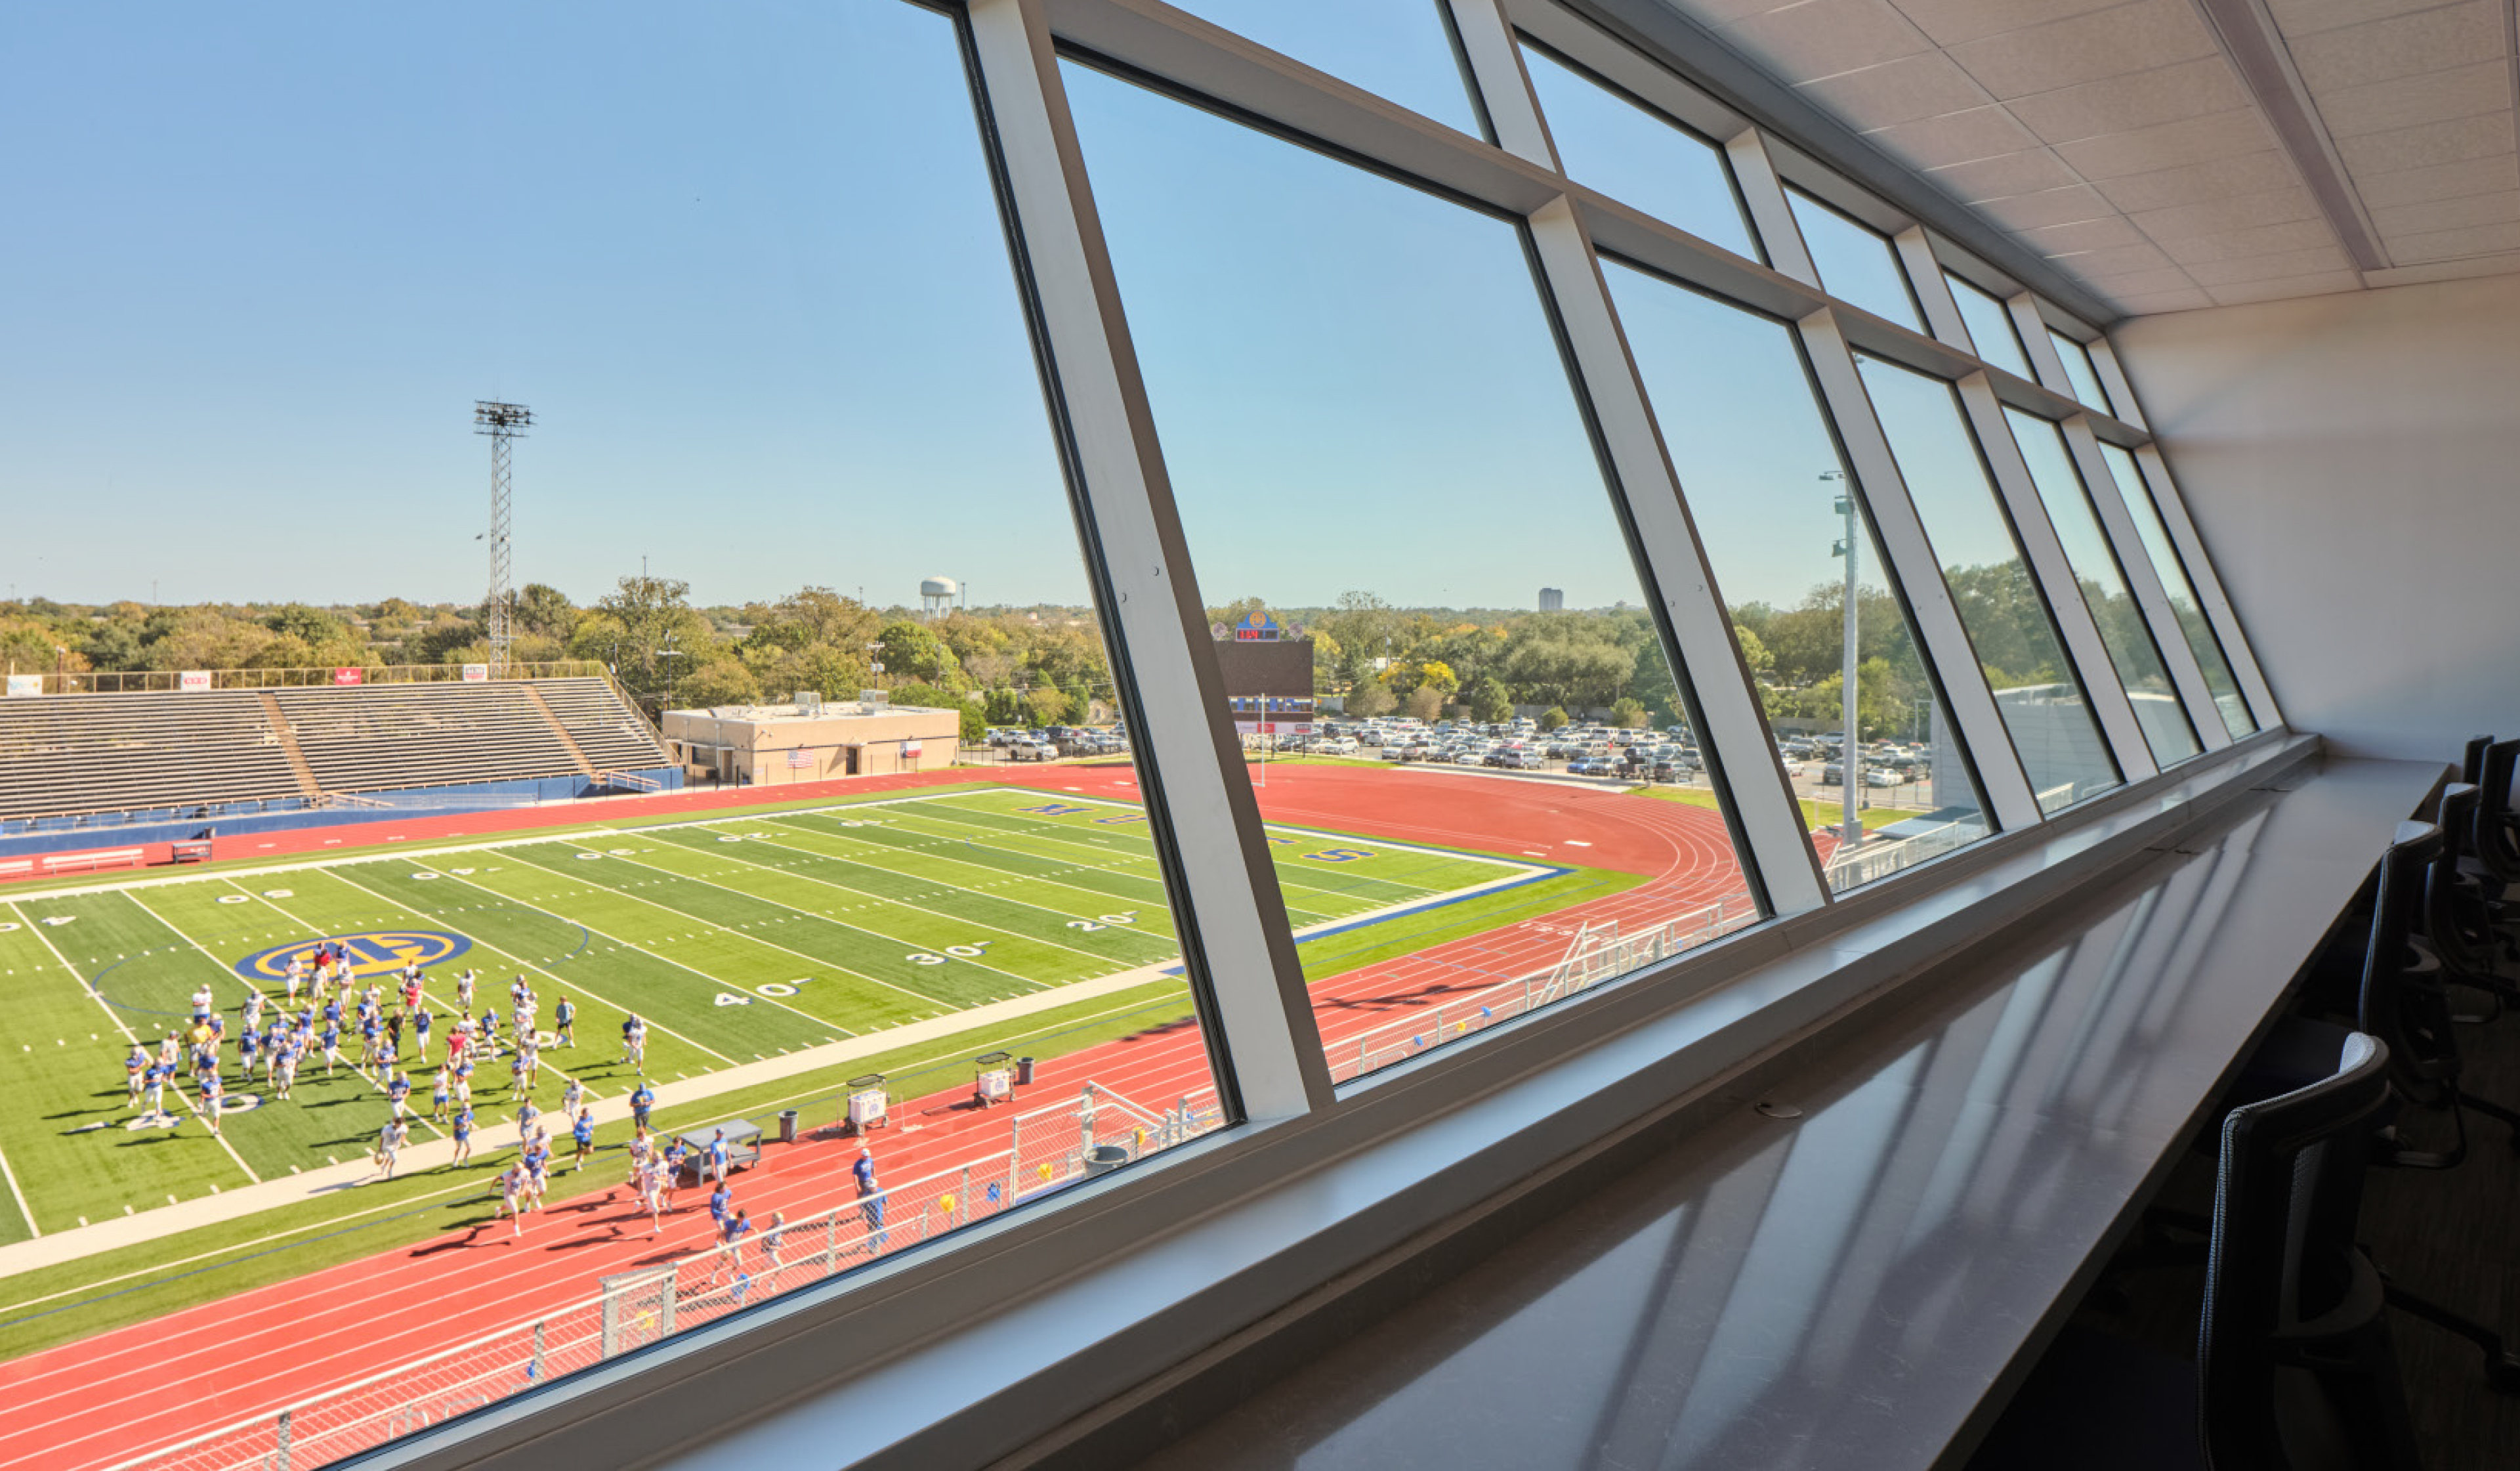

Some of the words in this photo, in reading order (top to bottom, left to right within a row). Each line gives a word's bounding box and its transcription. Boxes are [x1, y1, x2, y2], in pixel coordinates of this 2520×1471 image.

[1066, 914, 1137, 931] 20
[906, 945, 986, 966] 30
[715, 977, 801, 1007] 40
